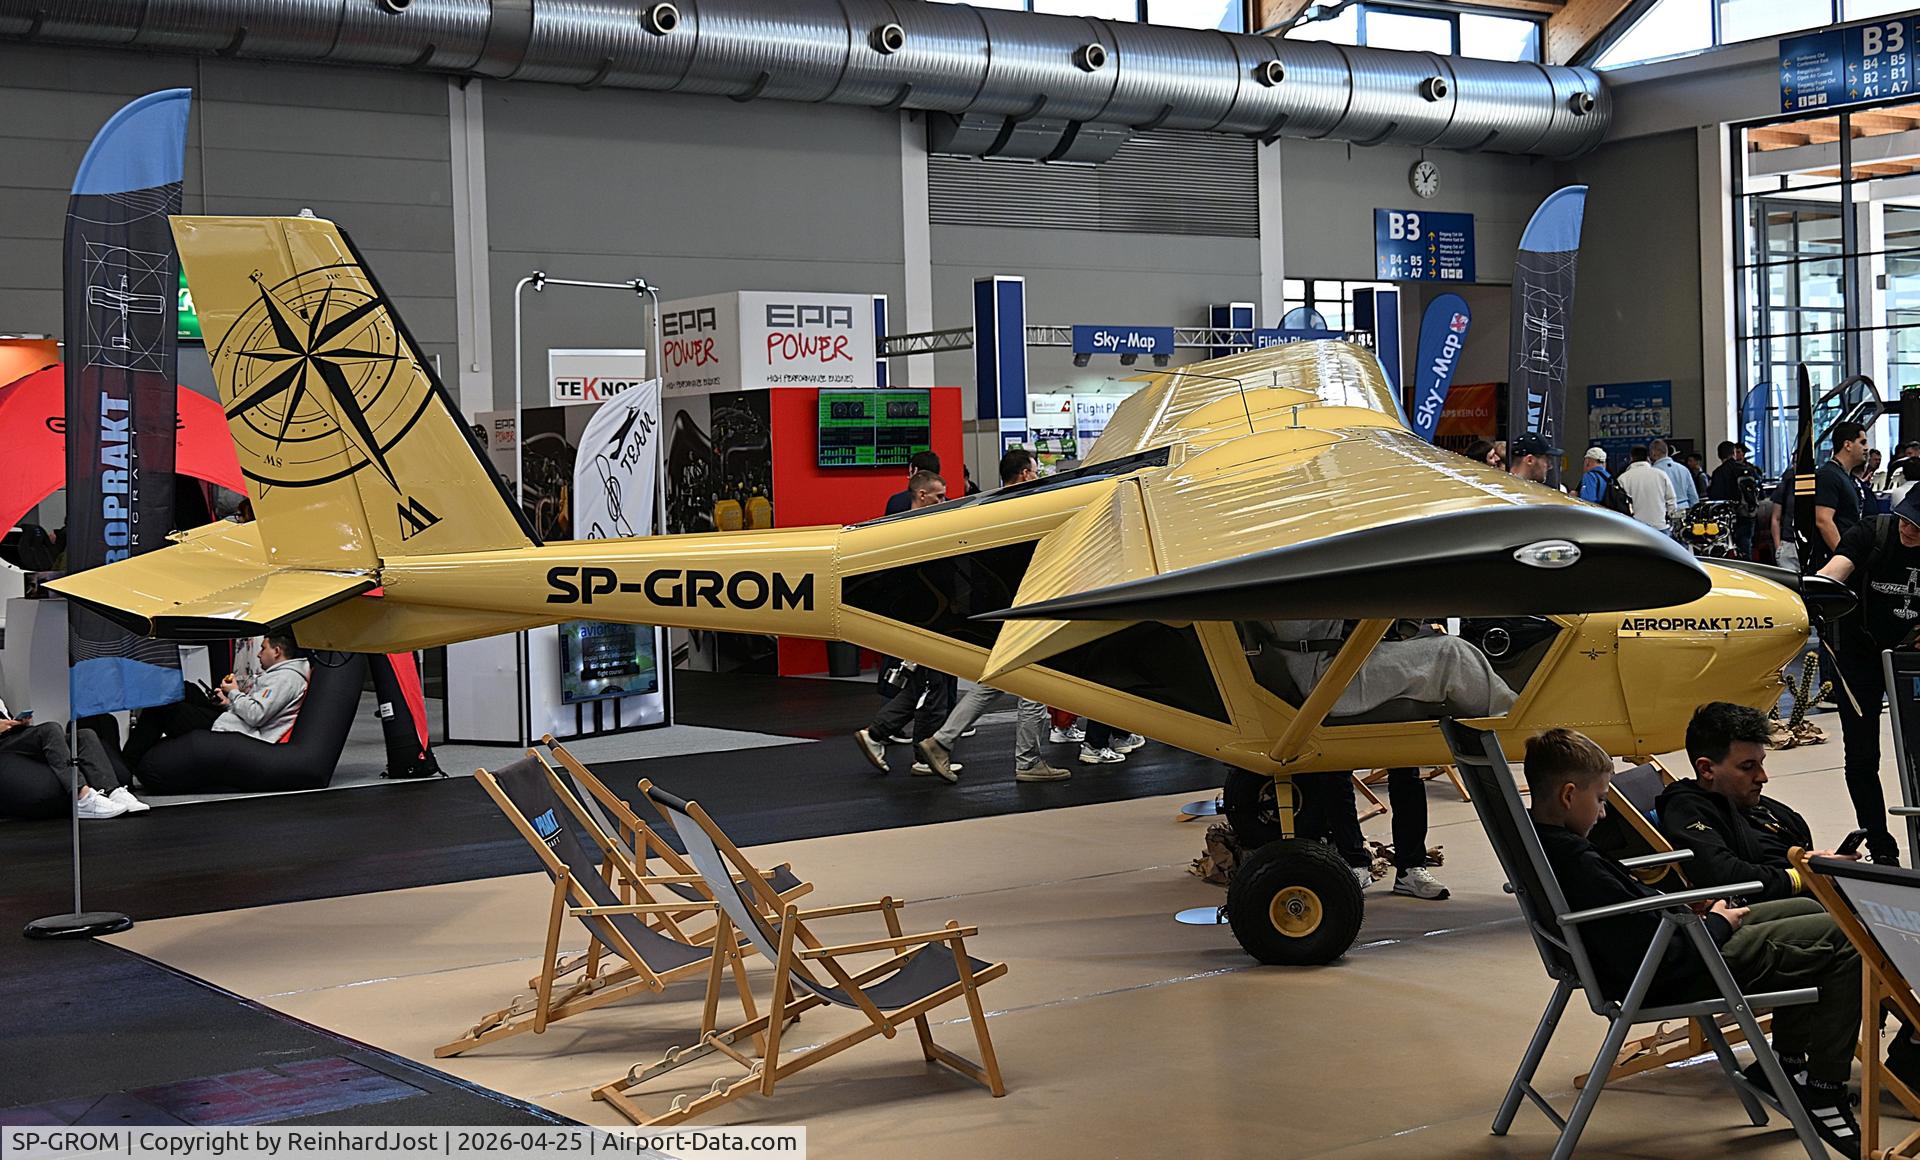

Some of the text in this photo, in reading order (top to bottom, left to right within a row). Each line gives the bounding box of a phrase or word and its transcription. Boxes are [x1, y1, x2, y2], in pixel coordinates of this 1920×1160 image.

[1863, 21, 1905, 57] B3
[1863, 58, 1878, 71] B4
[1890, 53, 1906, 67] B5
[1863, 71, 1878, 84] B2
[1890, 67, 1906, 80] B1
[1863, 85, 1879, 98] A1
[1890, 80, 1909, 94] A7
[1389, 212, 1421, 241] B3
[1390, 254, 1402, 265] B4
[1410, 255, 1422, 266] B5
[1390, 267, 1402, 278] A1
[1410, 268, 1423, 278] A7
[662, 307, 717, 337] EPA
[766, 304, 853, 329] EPA
[767, 332, 854, 365] POWER
[1093, 331, 1156, 352] Sky-Map
[663, 337, 719, 374] POWER
[557, 377, 645, 401] TEKNO
[783, 374, 827, 384] PERFORMANCE
[1416, 333, 1462, 430] Sky-Map
[1077, 402, 1117, 416] Flight Pl
[495, 418, 516, 430] EPA
[620, 411, 657, 475] TEAM
[545, 566, 815, 612] SP-GROM
[1621, 616, 1774, 631] AEROPRAKT 22LS
